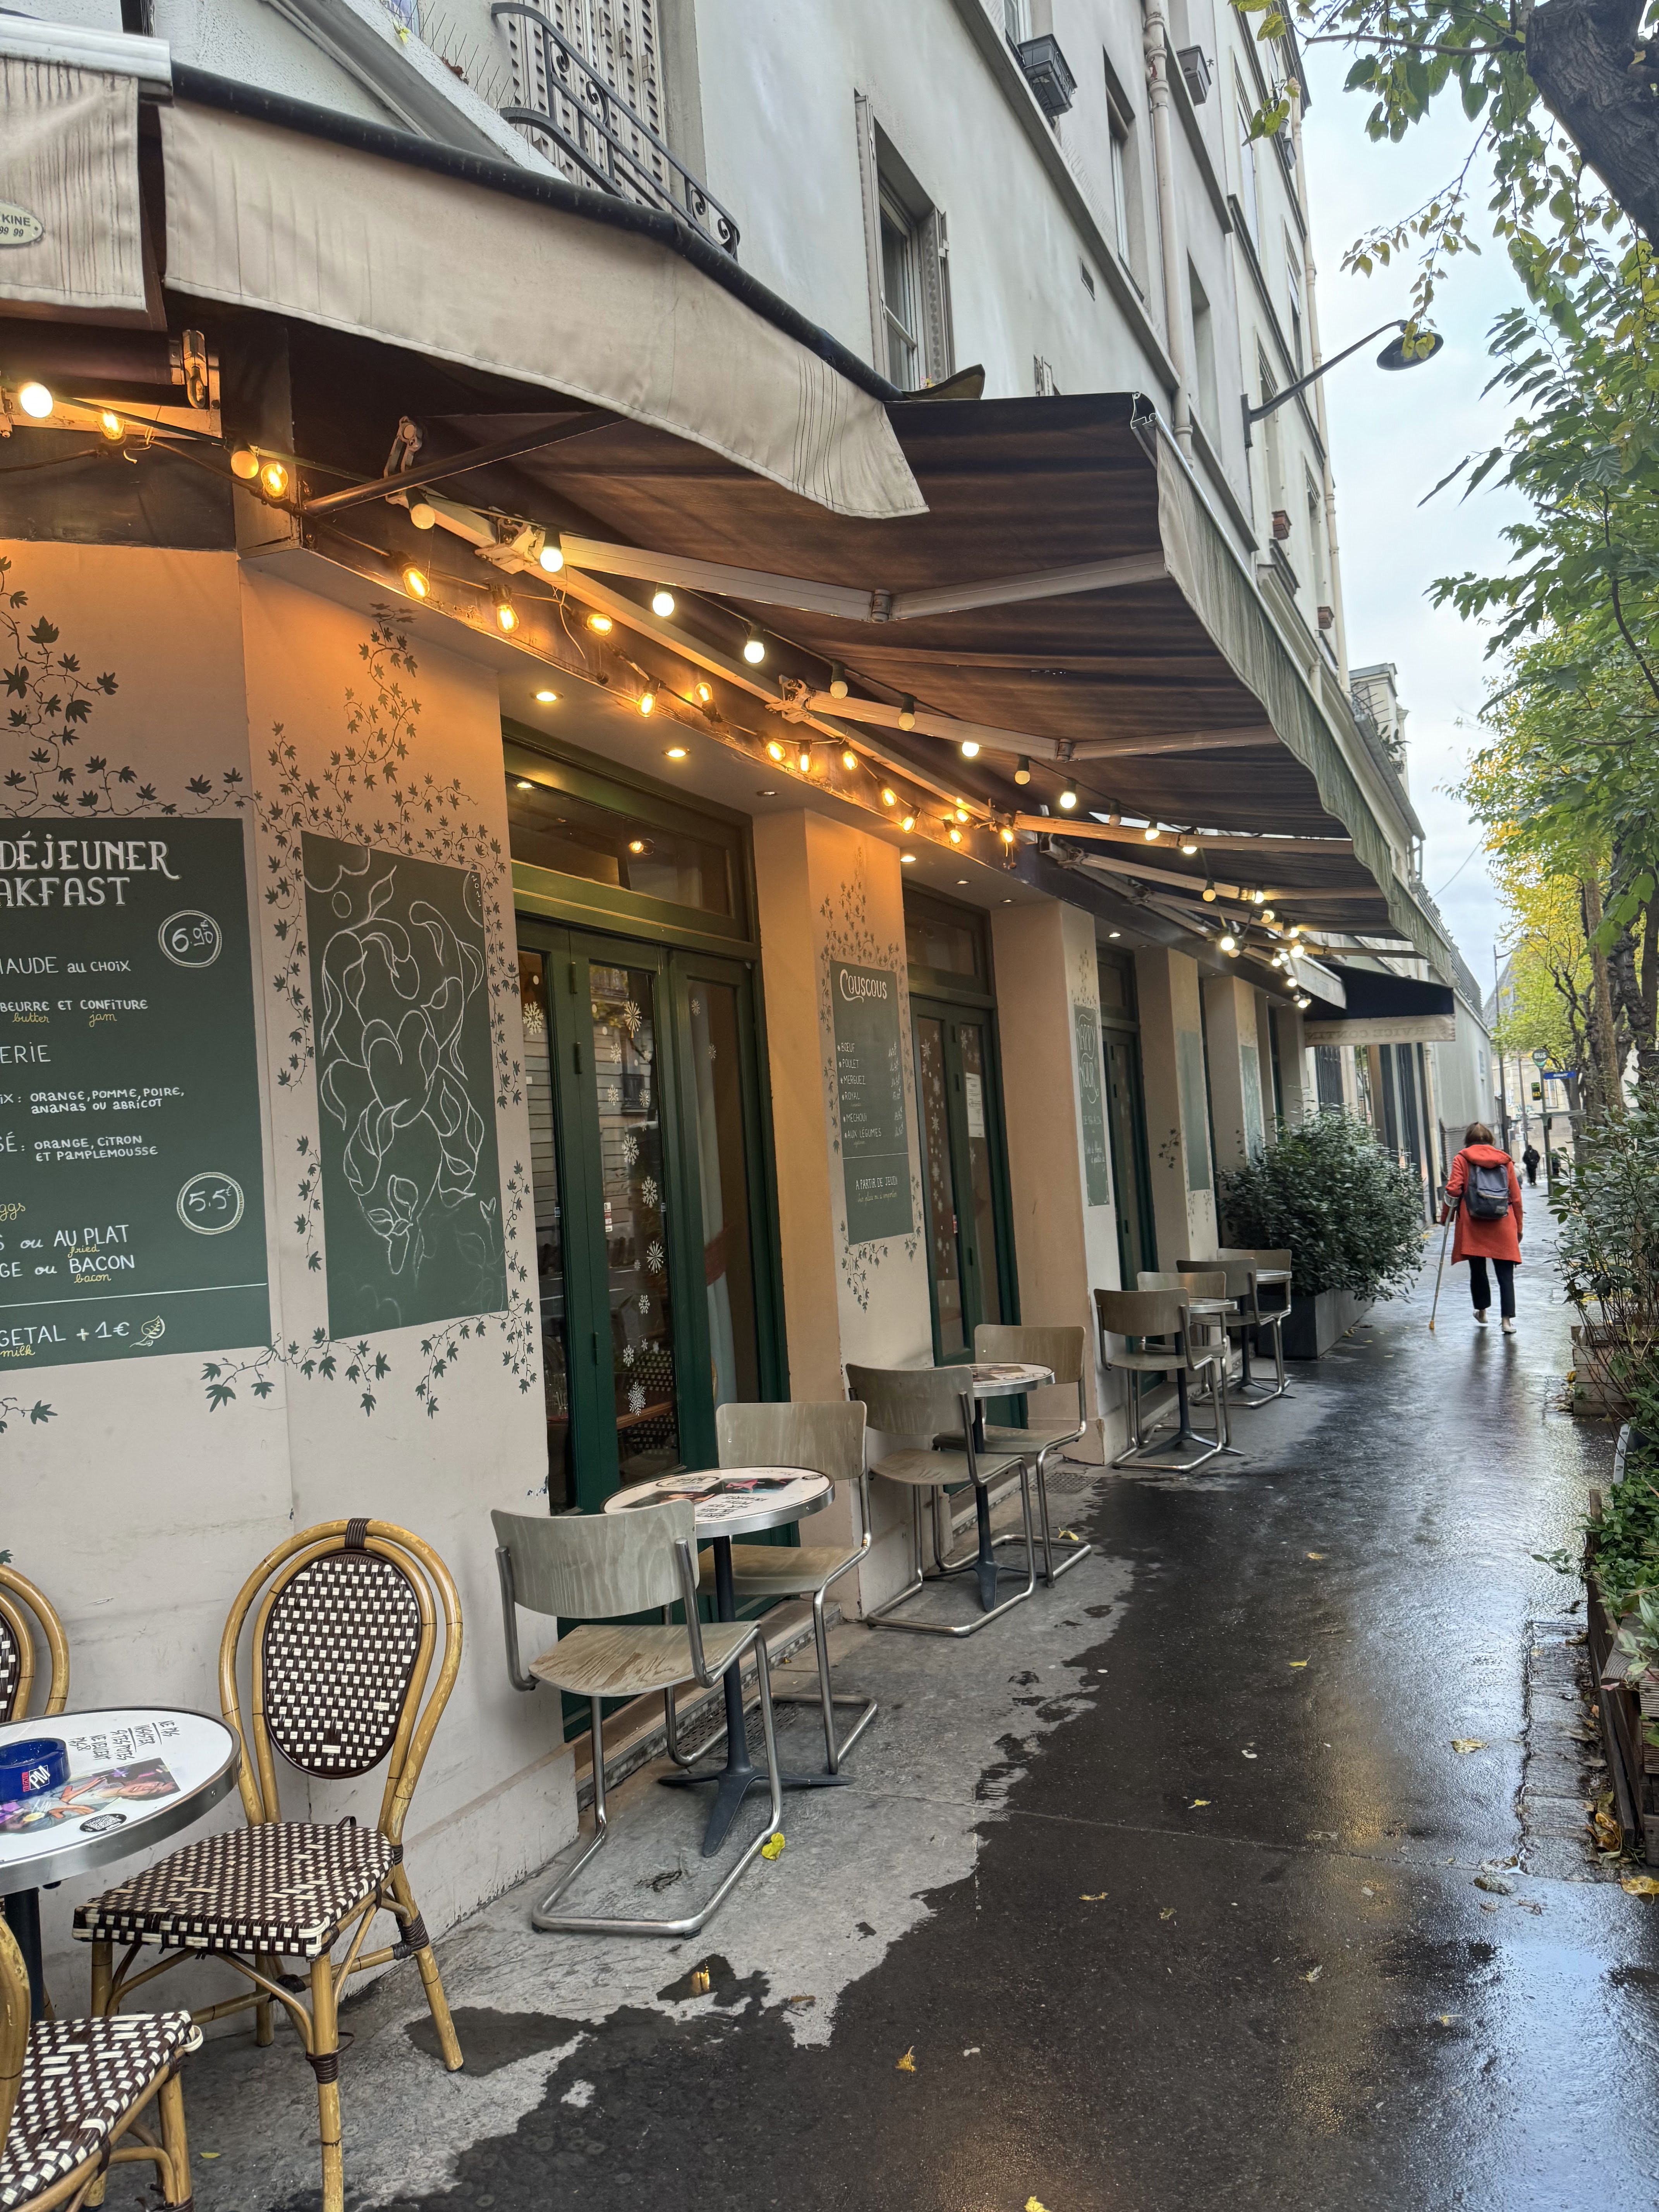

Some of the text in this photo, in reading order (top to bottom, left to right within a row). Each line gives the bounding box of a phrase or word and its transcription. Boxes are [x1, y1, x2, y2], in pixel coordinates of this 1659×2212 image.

[2, 214, 31, 227] KINE
[58, 1001, 72, 1010] ET
[12, 1012, 117, 1027] butter jam
[842, 1059, 859, 1068] POULET
[844, 1075, 866, 1084] MERGUEZ
[845, 1092, 860, 1100] ROYAL
[93, 1102, 106, 1110] OU
[847, 1130, 857, 1138] AUX
[36, 1152, 51, 1161] ET
[21, 1239, 43, 1249] ou
[54, 1230, 77, 1247] AU
[84, 1224, 129, 1245] PLAT
[68, 1243, 100, 1258] fried
[35, 1266, 57, 1275] ou
[70, 1255, 135, 1274] BACON
[74, 1273, 112, 1283] bacon
[0, 1345, 35, 1357] milk
